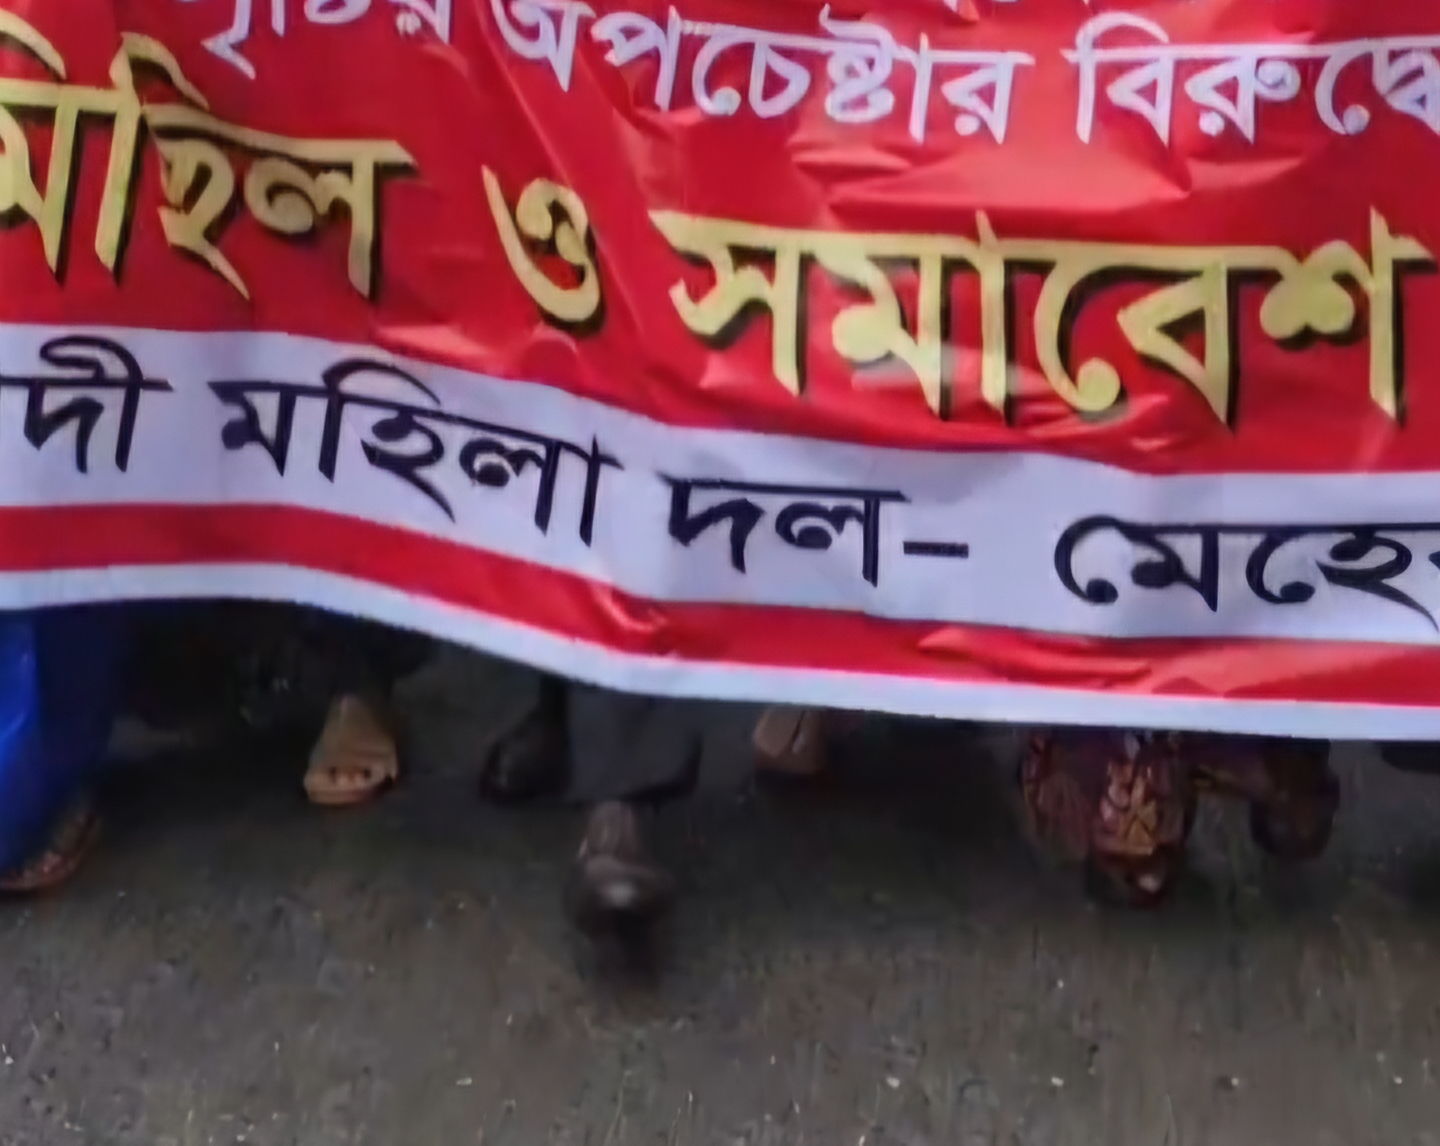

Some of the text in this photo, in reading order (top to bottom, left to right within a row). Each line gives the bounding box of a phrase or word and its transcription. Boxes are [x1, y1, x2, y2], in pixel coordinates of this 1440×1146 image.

[481, 165, 604, 331] ও
[647, 207, 1438, 432] সমাবেশ
[207, 358, 624, 548] মহিলা
